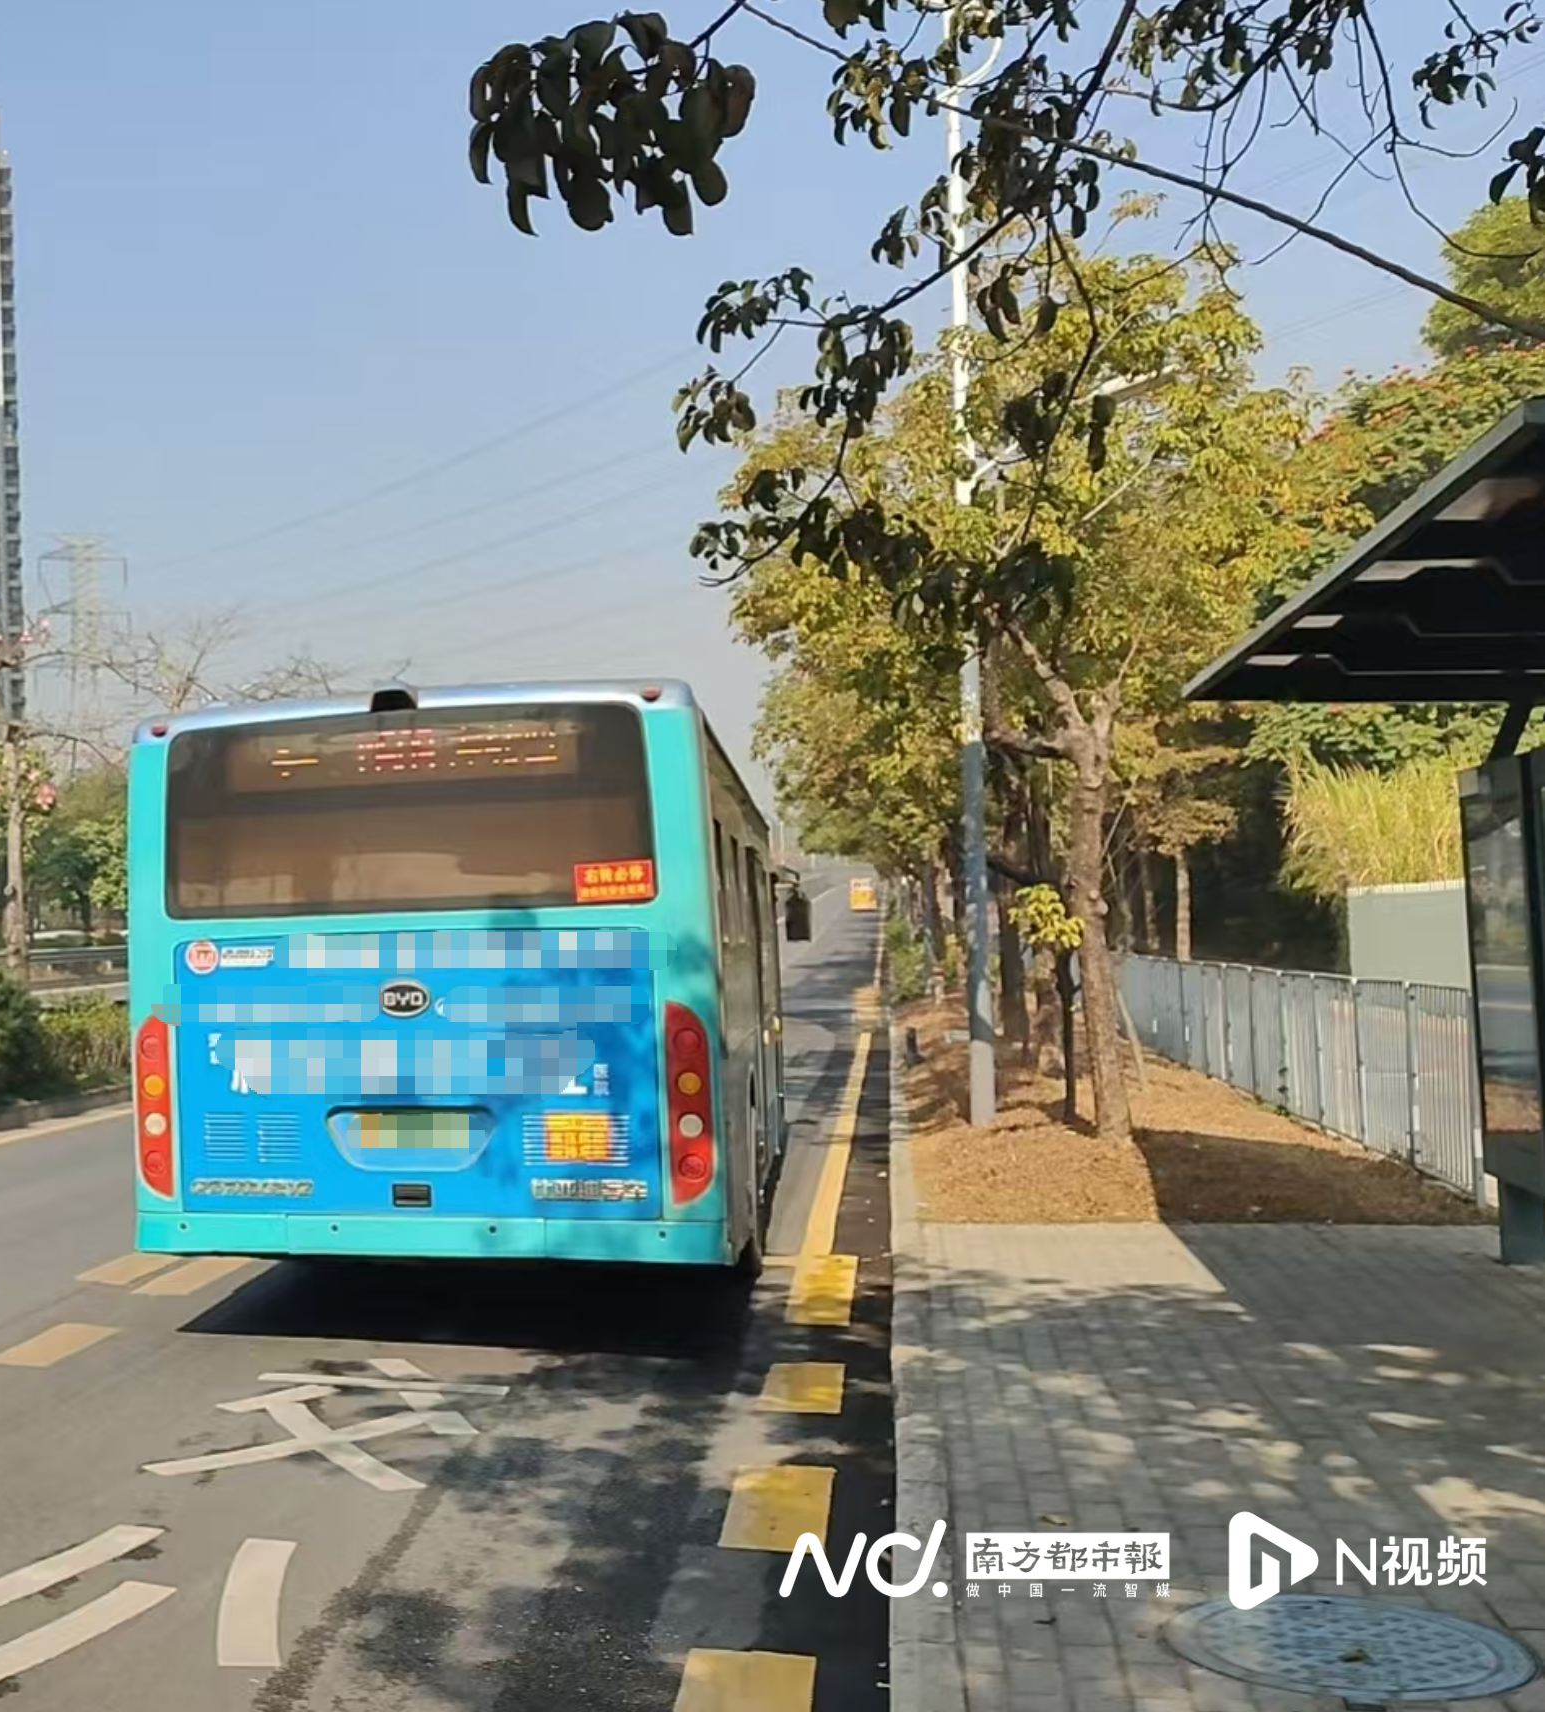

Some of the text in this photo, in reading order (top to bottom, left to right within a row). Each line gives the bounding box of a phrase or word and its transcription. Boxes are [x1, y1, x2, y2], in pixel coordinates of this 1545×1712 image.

[383, 991, 424, 1007] BYD
[530, 1177, 648, 1201] 比亚迪客车
